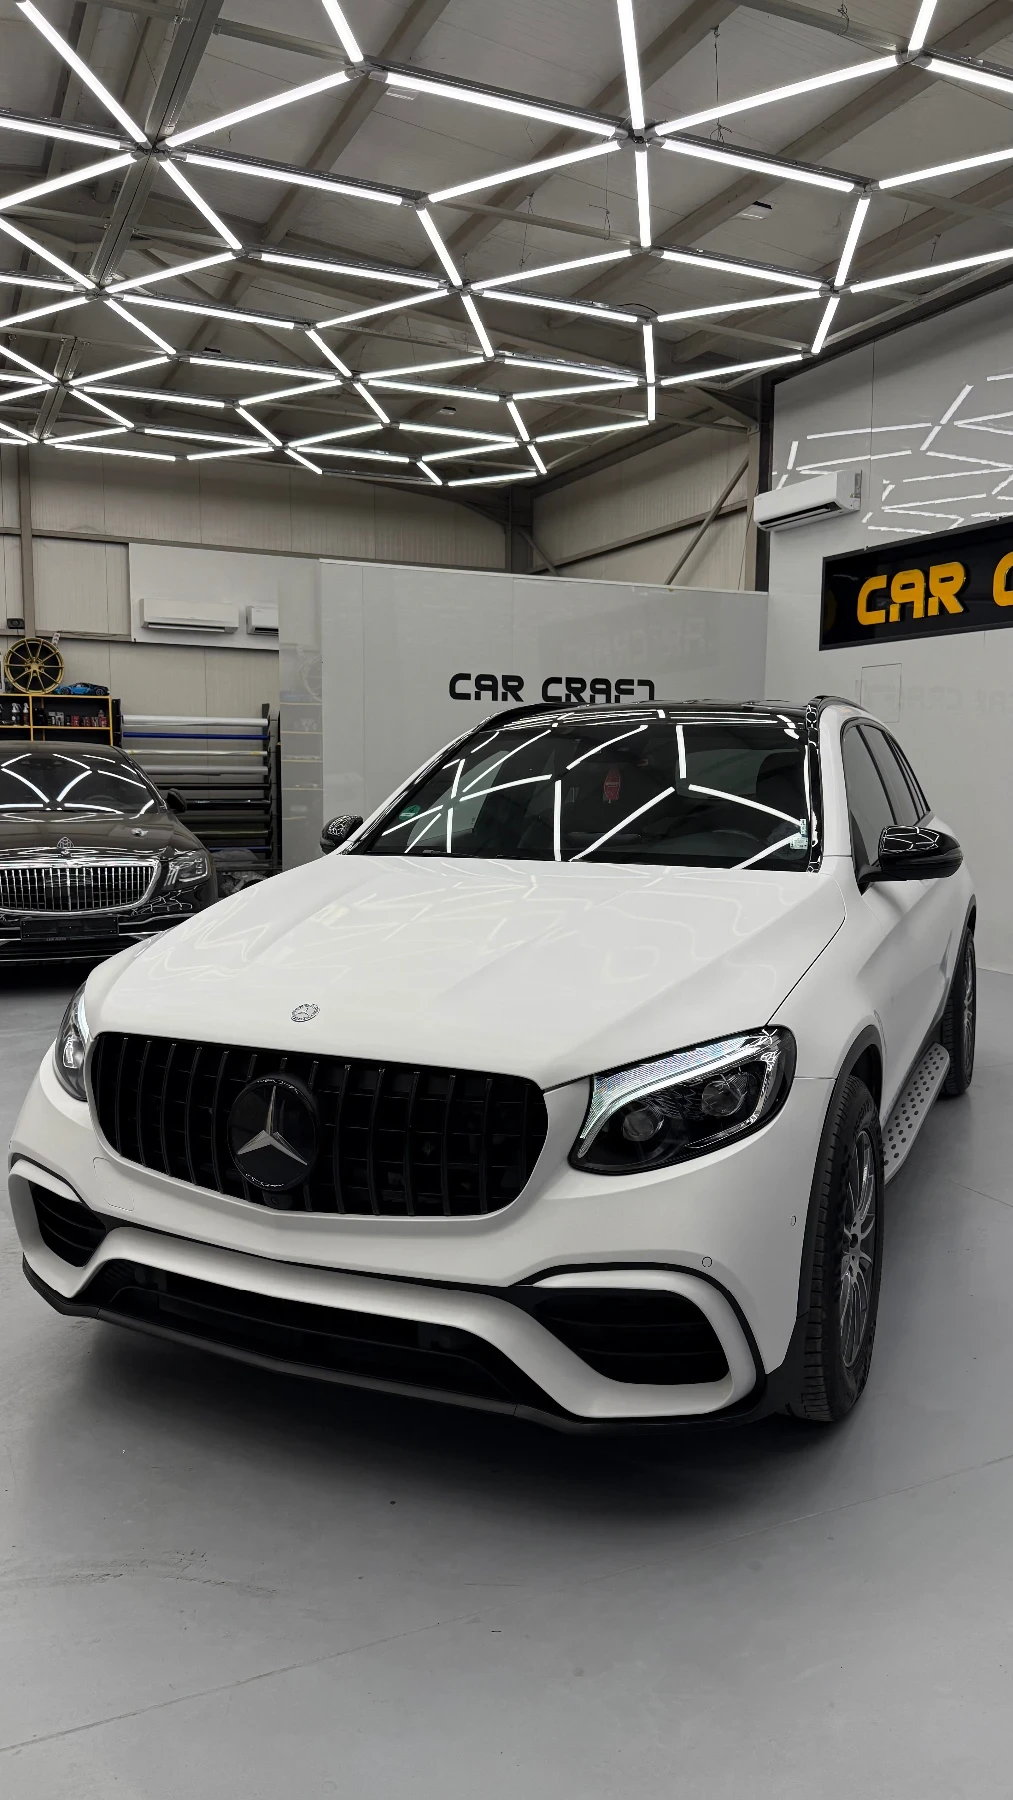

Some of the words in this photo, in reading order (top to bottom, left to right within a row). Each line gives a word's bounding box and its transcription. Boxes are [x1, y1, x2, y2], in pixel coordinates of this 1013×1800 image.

[857, 561, 966, 626] CAR
[449, 673, 524, 702] CAR
[541, 676, 655, 703] CRAFT
